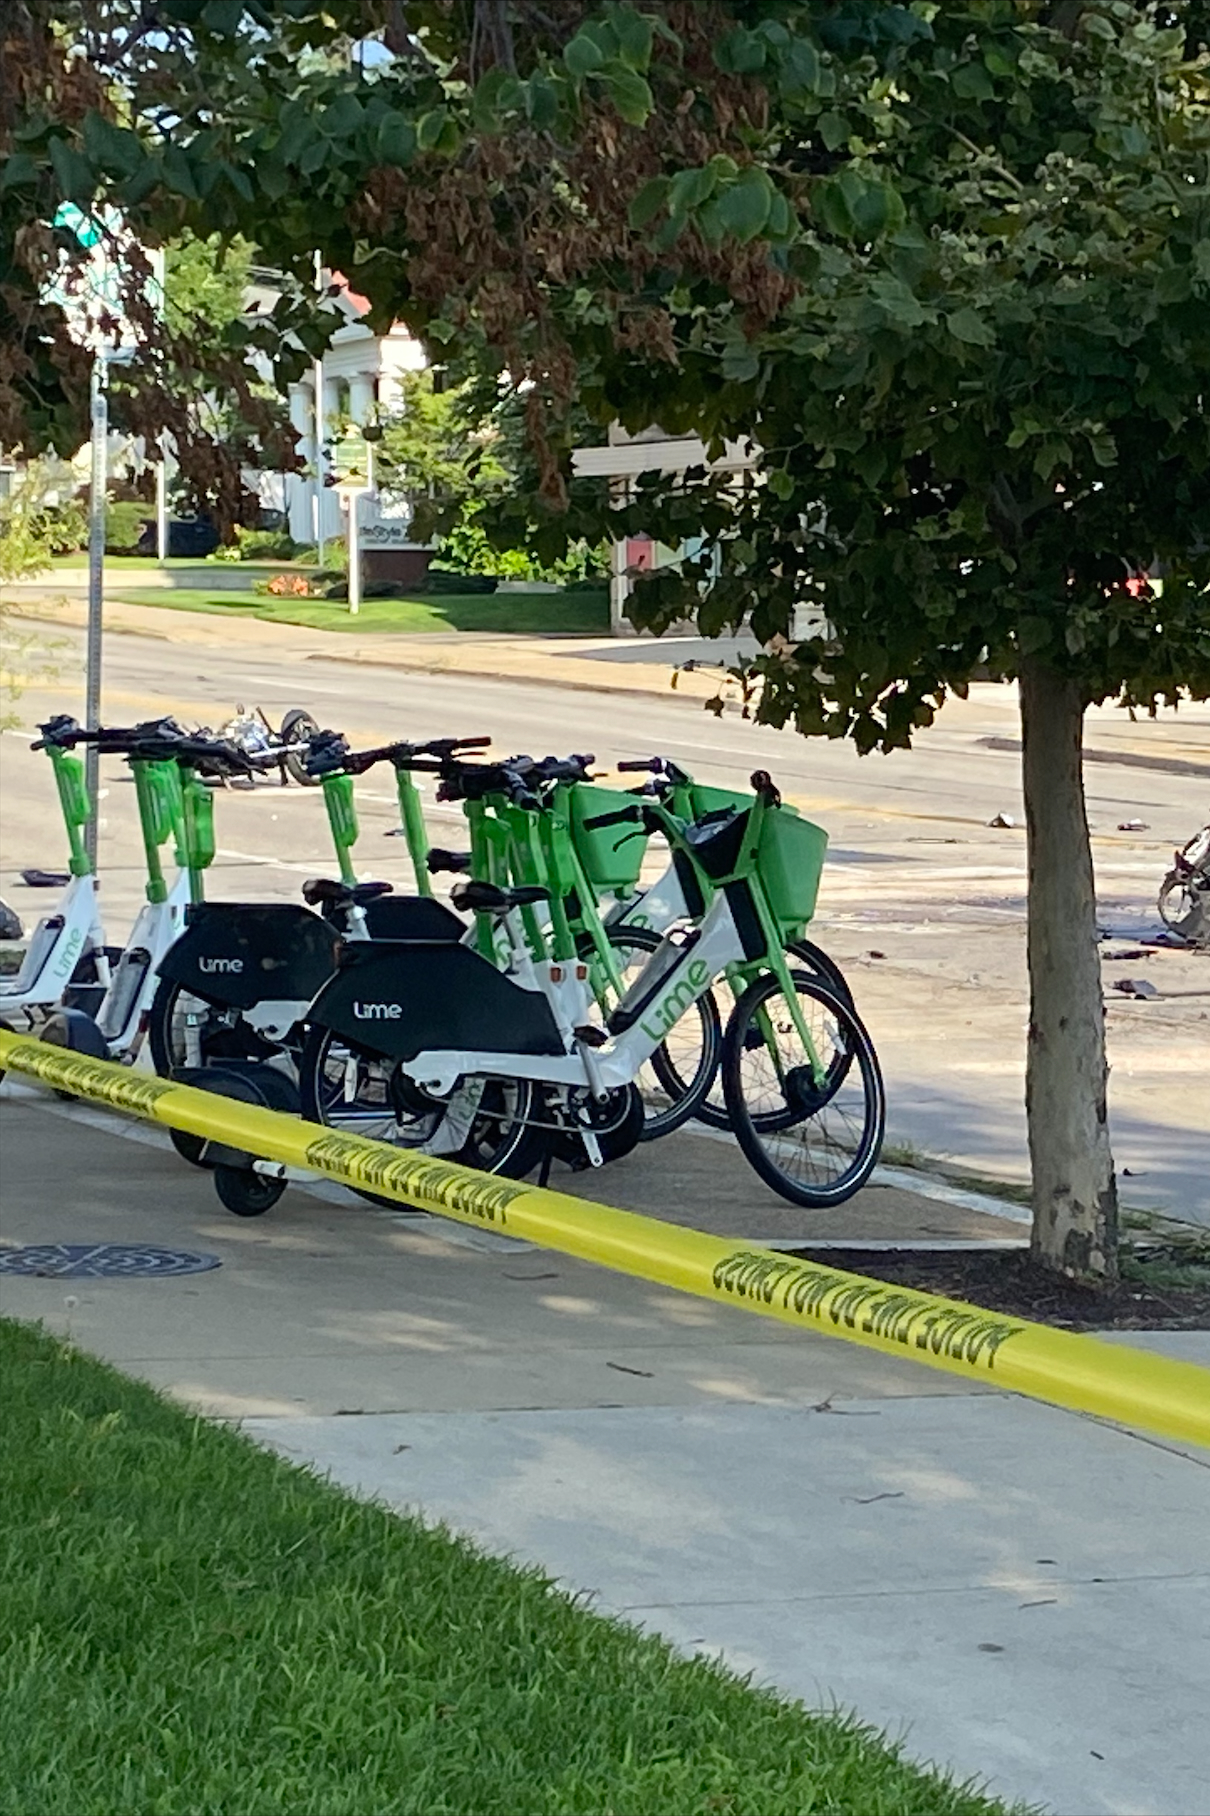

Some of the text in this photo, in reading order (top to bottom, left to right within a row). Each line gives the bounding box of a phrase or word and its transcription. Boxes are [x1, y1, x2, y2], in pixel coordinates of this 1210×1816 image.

[53, 927, 82, 978] Lime
[198, 956, 244, 974] Lime
[353, 1001, 403, 1019] Lime
[639, 958, 711, 1042] Lime
